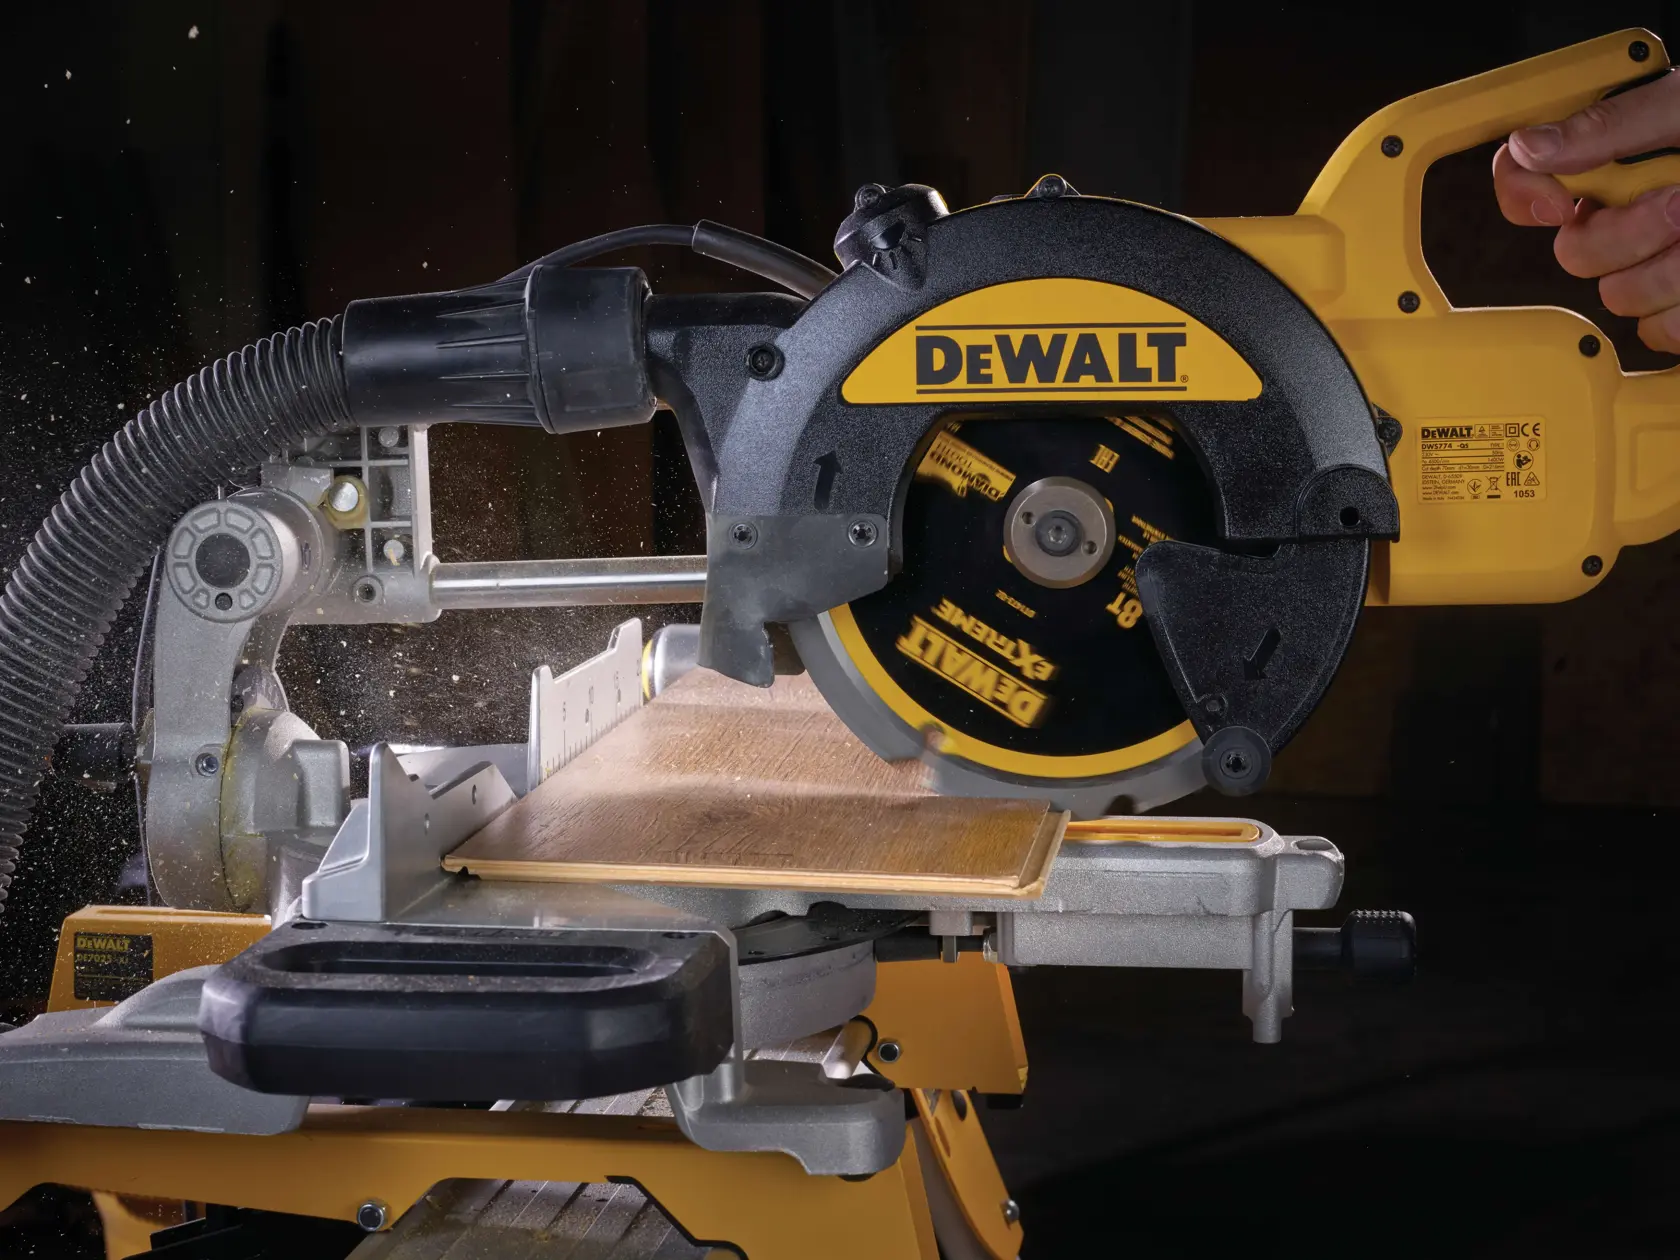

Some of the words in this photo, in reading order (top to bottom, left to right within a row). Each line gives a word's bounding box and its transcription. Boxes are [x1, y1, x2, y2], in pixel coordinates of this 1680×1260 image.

[916, 332, 1187, 386] DEWALT
[1421, 427, 1473, 439] DEWALT
[929, 451, 1001, 499] DIAMOND
[1514, 490, 1535, 498] 1053
[1105, 592, 1143, 629] 8T
[931, 597, 1057, 681] EXTREME
[898, 617, 1046, 726] DEWALT
[77, 937, 131, 951] DEWALT
